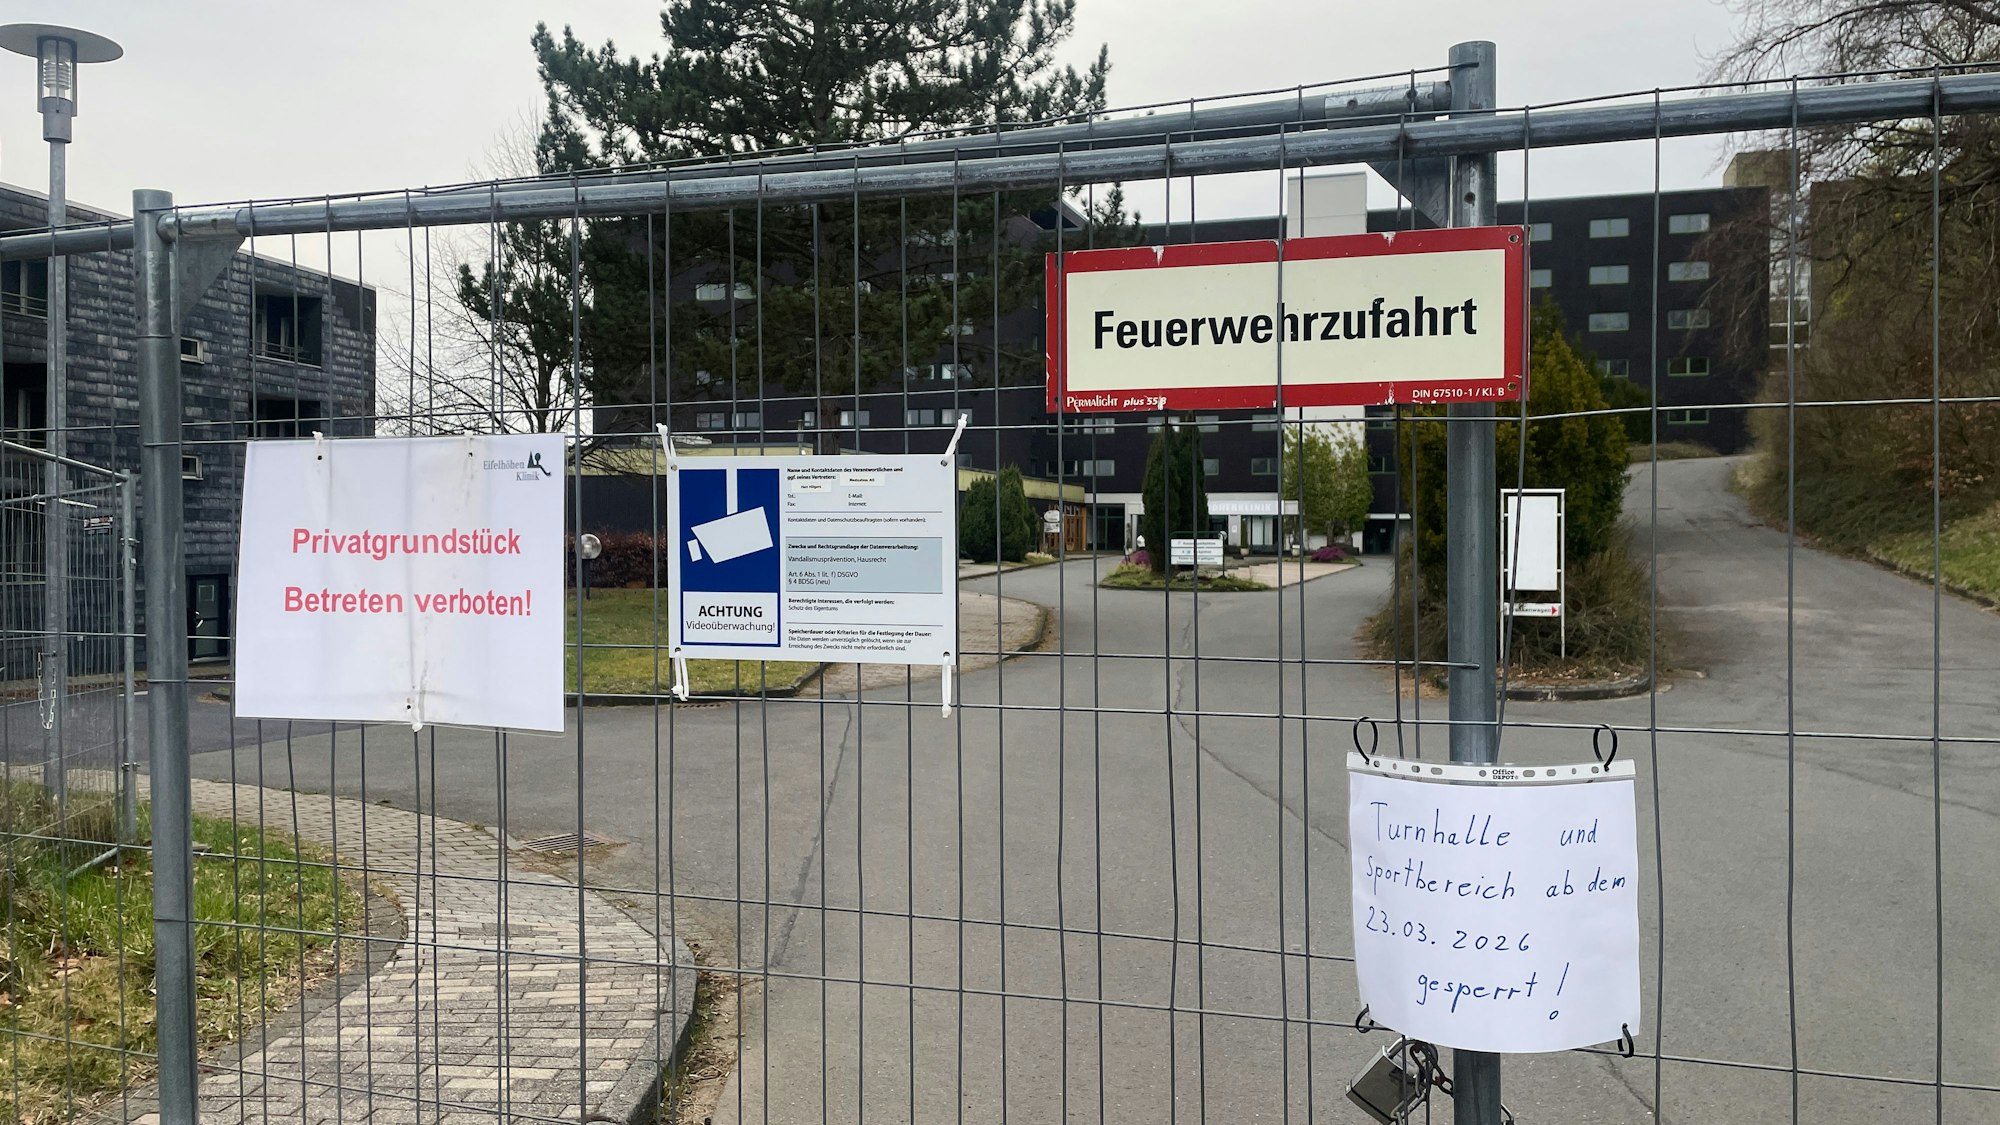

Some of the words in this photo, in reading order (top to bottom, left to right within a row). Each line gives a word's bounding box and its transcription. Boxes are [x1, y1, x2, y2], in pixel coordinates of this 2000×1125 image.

[1094, 295, 1477, 350] Feuerwehrzufahrt
[1123, 397, 1144, 408] plus
[1412, 389, 1430, 398] DIN
[1433, 388, 1473, 397] 67510-1
[1498, 387, 1505, 396] B
[483, 460, 525, 470] Eifelhöhen
[516, 471, 540, 481] Klinik
[292, 528, 521, 561] Privatgrundstück
[284, 586, 403, 613] Betreten
[414, 588, 531, 616] verboten!
[698, 605, 763, 618] ACHTUNG
[686, 620, 776, 633] Videoüberwachung!
[1370, 801, 1511, 846] Turnhalle
[1560, 818, 1599, 845] und
[1366, 855, 1515, 900] Sportbereich
[1546, 869, 1574, 898] ab
[1587, 866, 1626, 891] dem
[1365, 906, 1436, 945] 23.03.
[1451, 930, 1530, 951] 2026
[1416, 971, 1538, 1014] gesperrt
